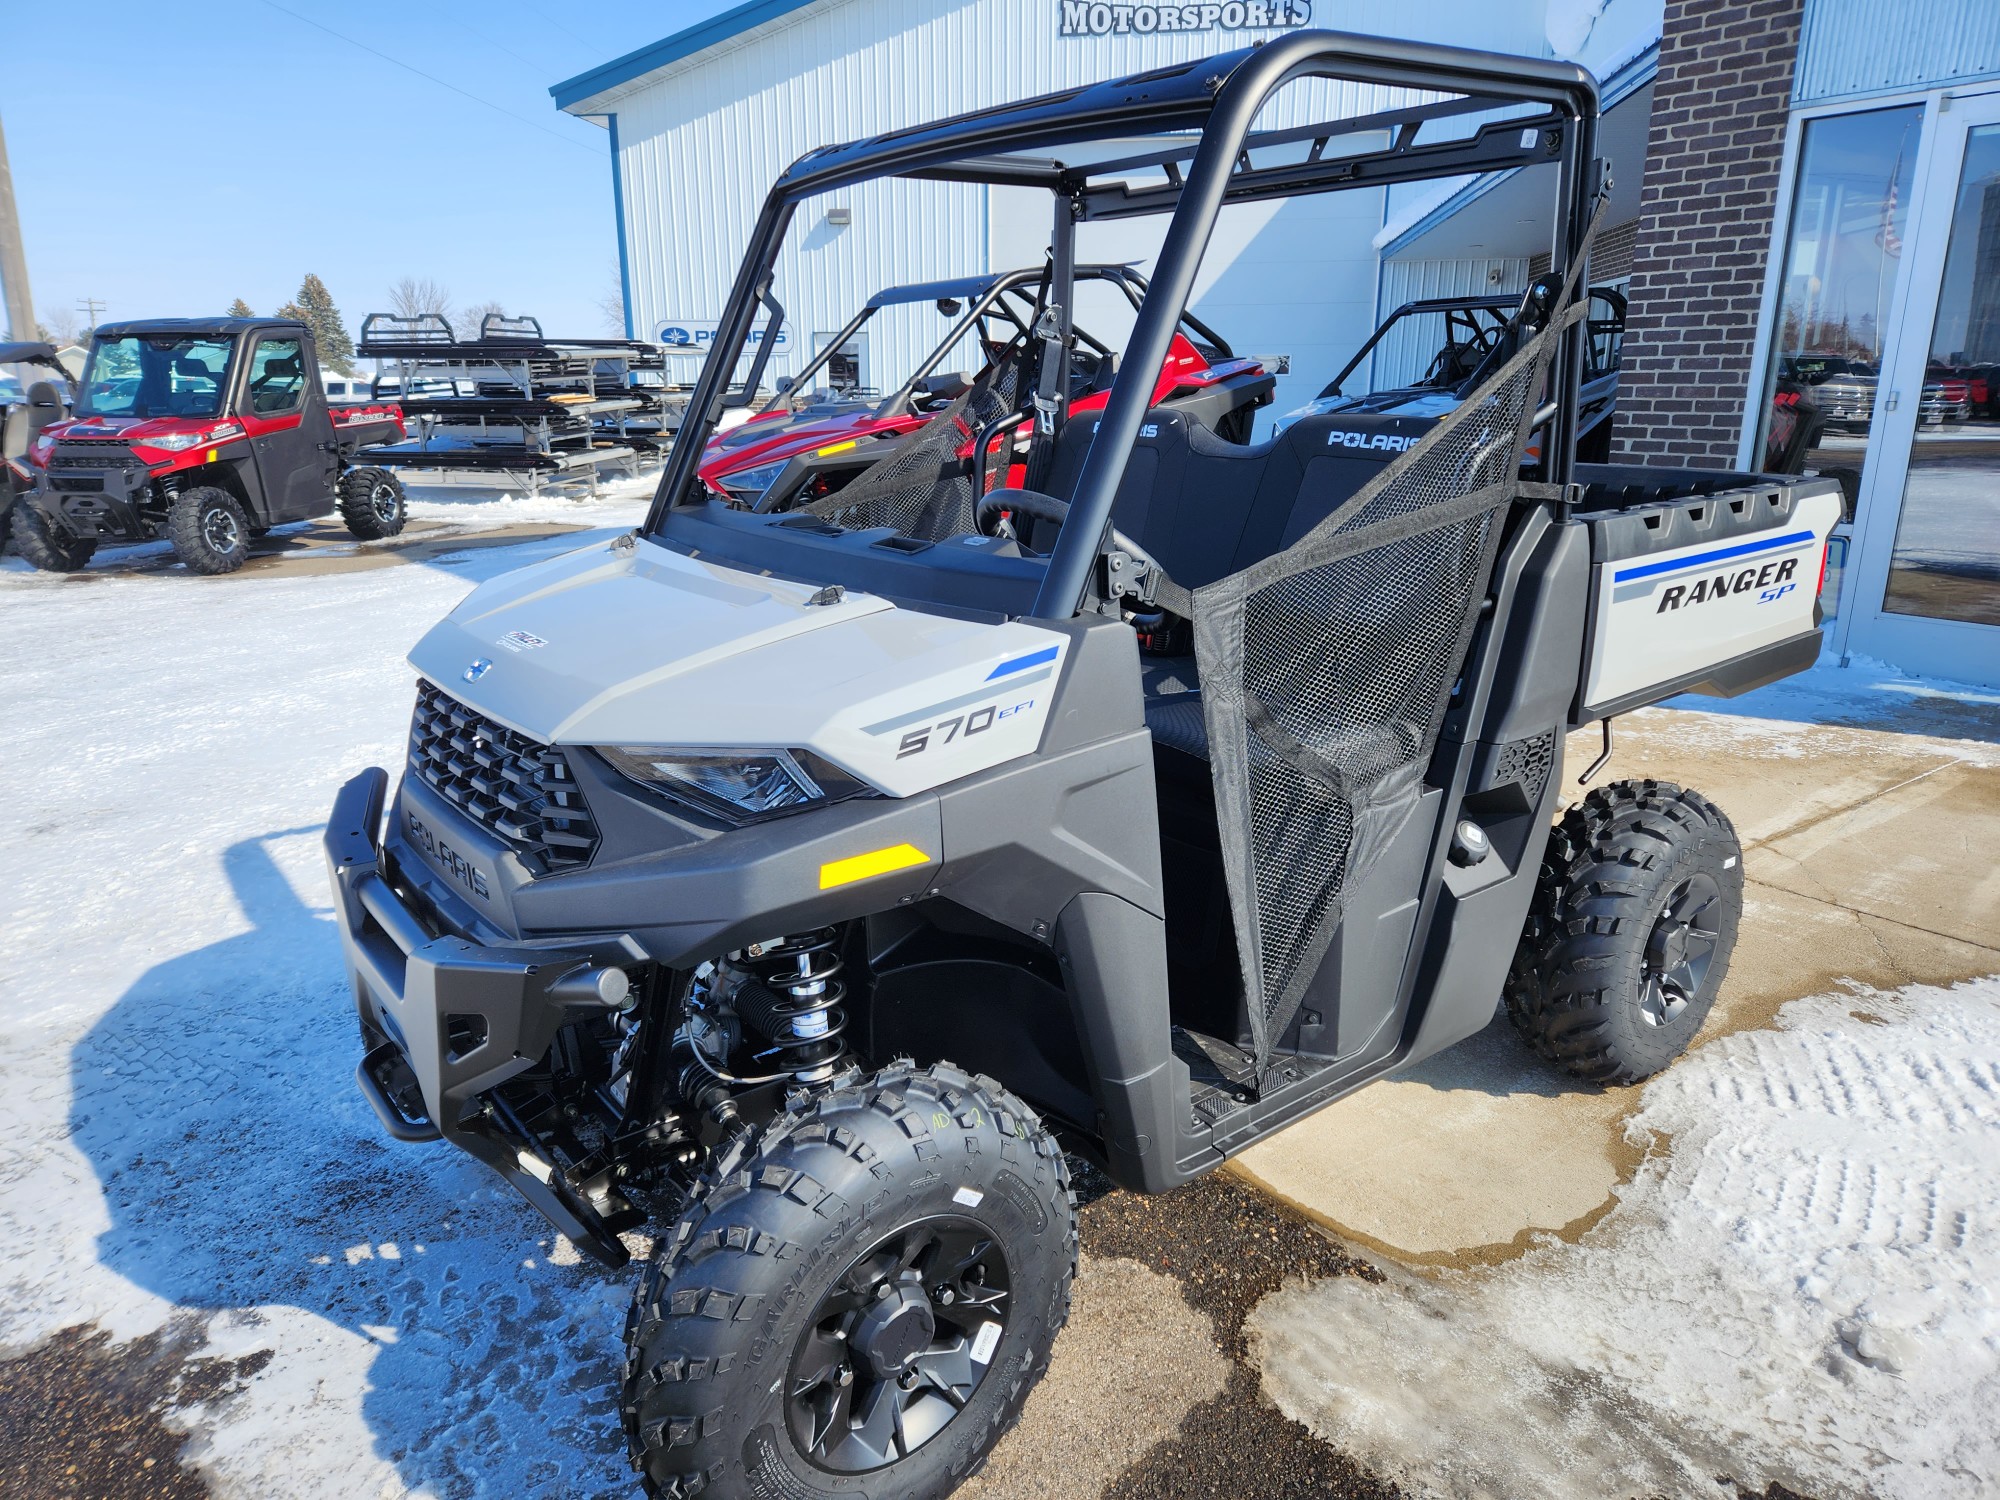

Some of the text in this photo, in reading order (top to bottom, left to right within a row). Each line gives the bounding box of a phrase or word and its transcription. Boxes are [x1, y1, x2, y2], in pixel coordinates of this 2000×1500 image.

[1061, 0, 1311, 36] MOTORSPORTS
[1657, 558, 1798, 614] RANGER
[1757, 583, 1797, 605] SP
[896, 700, 1034, 761] 570 EFI
[408, 810, 490, 902] POLARIS
[748, 1192, 883, 1366] CARLISLE
[951, 1347, 1035, 1477] AT489
